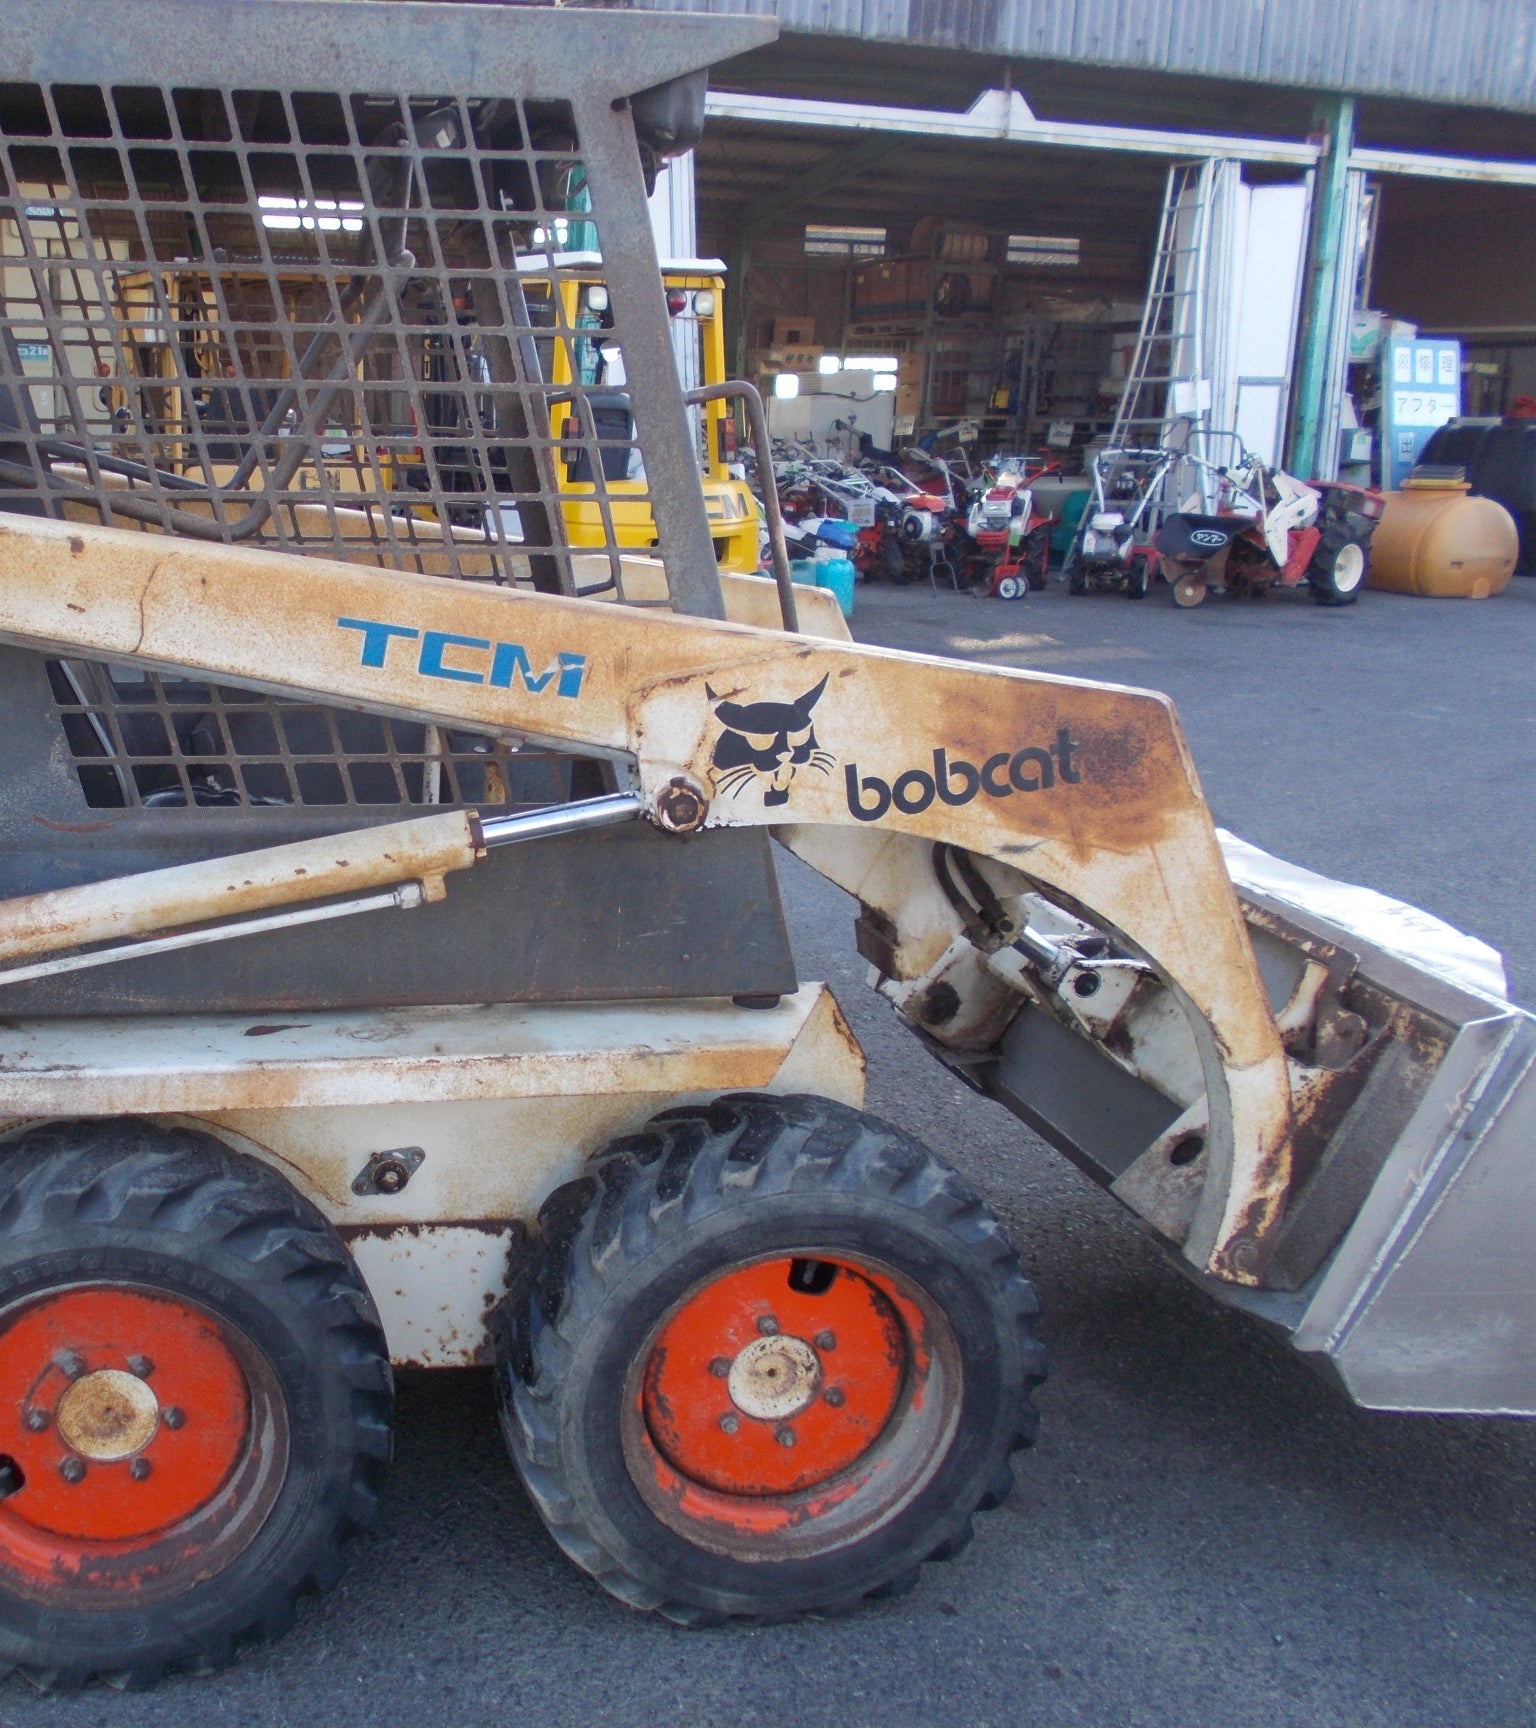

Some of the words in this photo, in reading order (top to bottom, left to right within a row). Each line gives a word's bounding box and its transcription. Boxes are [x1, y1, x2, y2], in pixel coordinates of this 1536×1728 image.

[1397, 397, 1454, 413] アフター
[1196, 532, 1227, 545] ヤンマー
[337, 616, 587, 699] TCM
[844, 728, 1082, 822] bobcat
